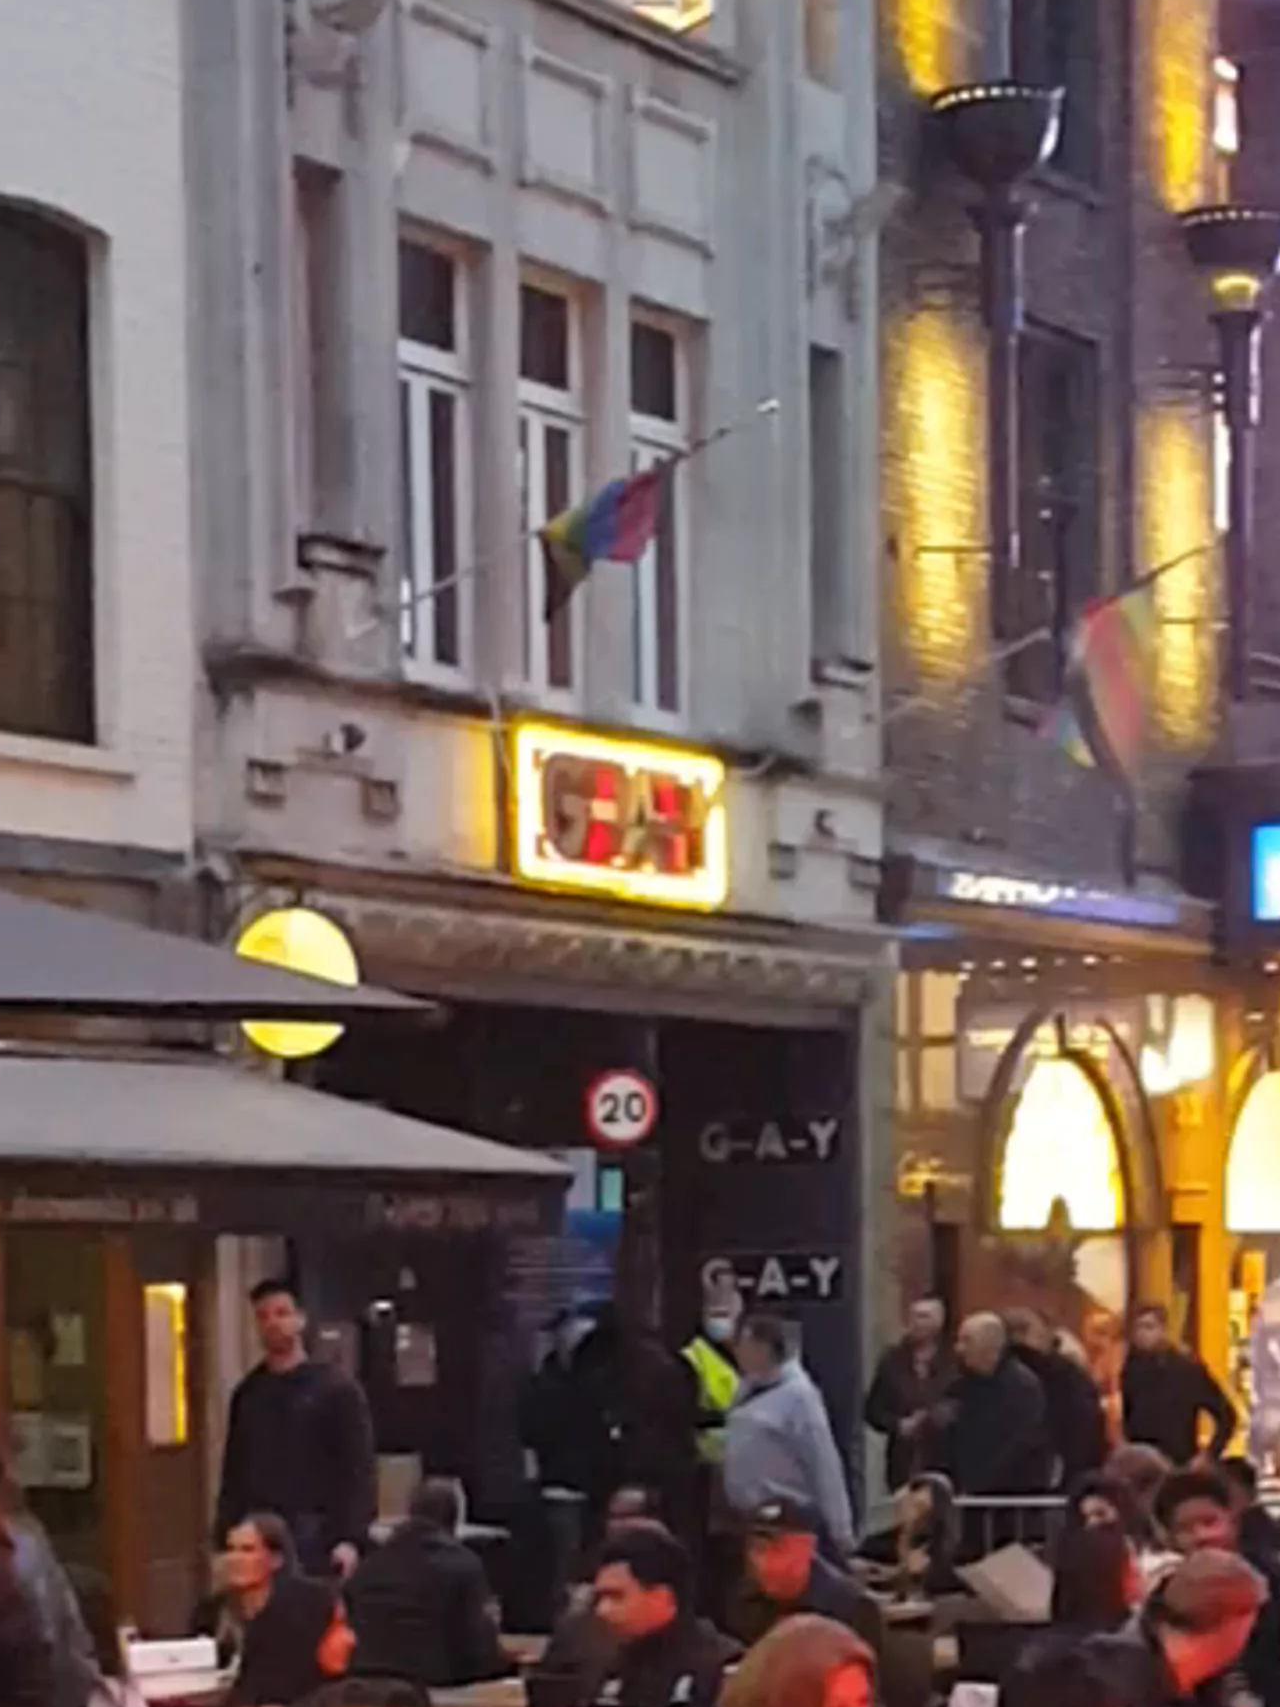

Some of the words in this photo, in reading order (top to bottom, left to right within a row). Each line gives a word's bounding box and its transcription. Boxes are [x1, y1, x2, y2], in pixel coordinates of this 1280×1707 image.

[600, 1092, 646, 1123] 20
[699, 1118, 838, 1162] G-A-Y
[701, 1256, 839, 1296] G-A-Y
